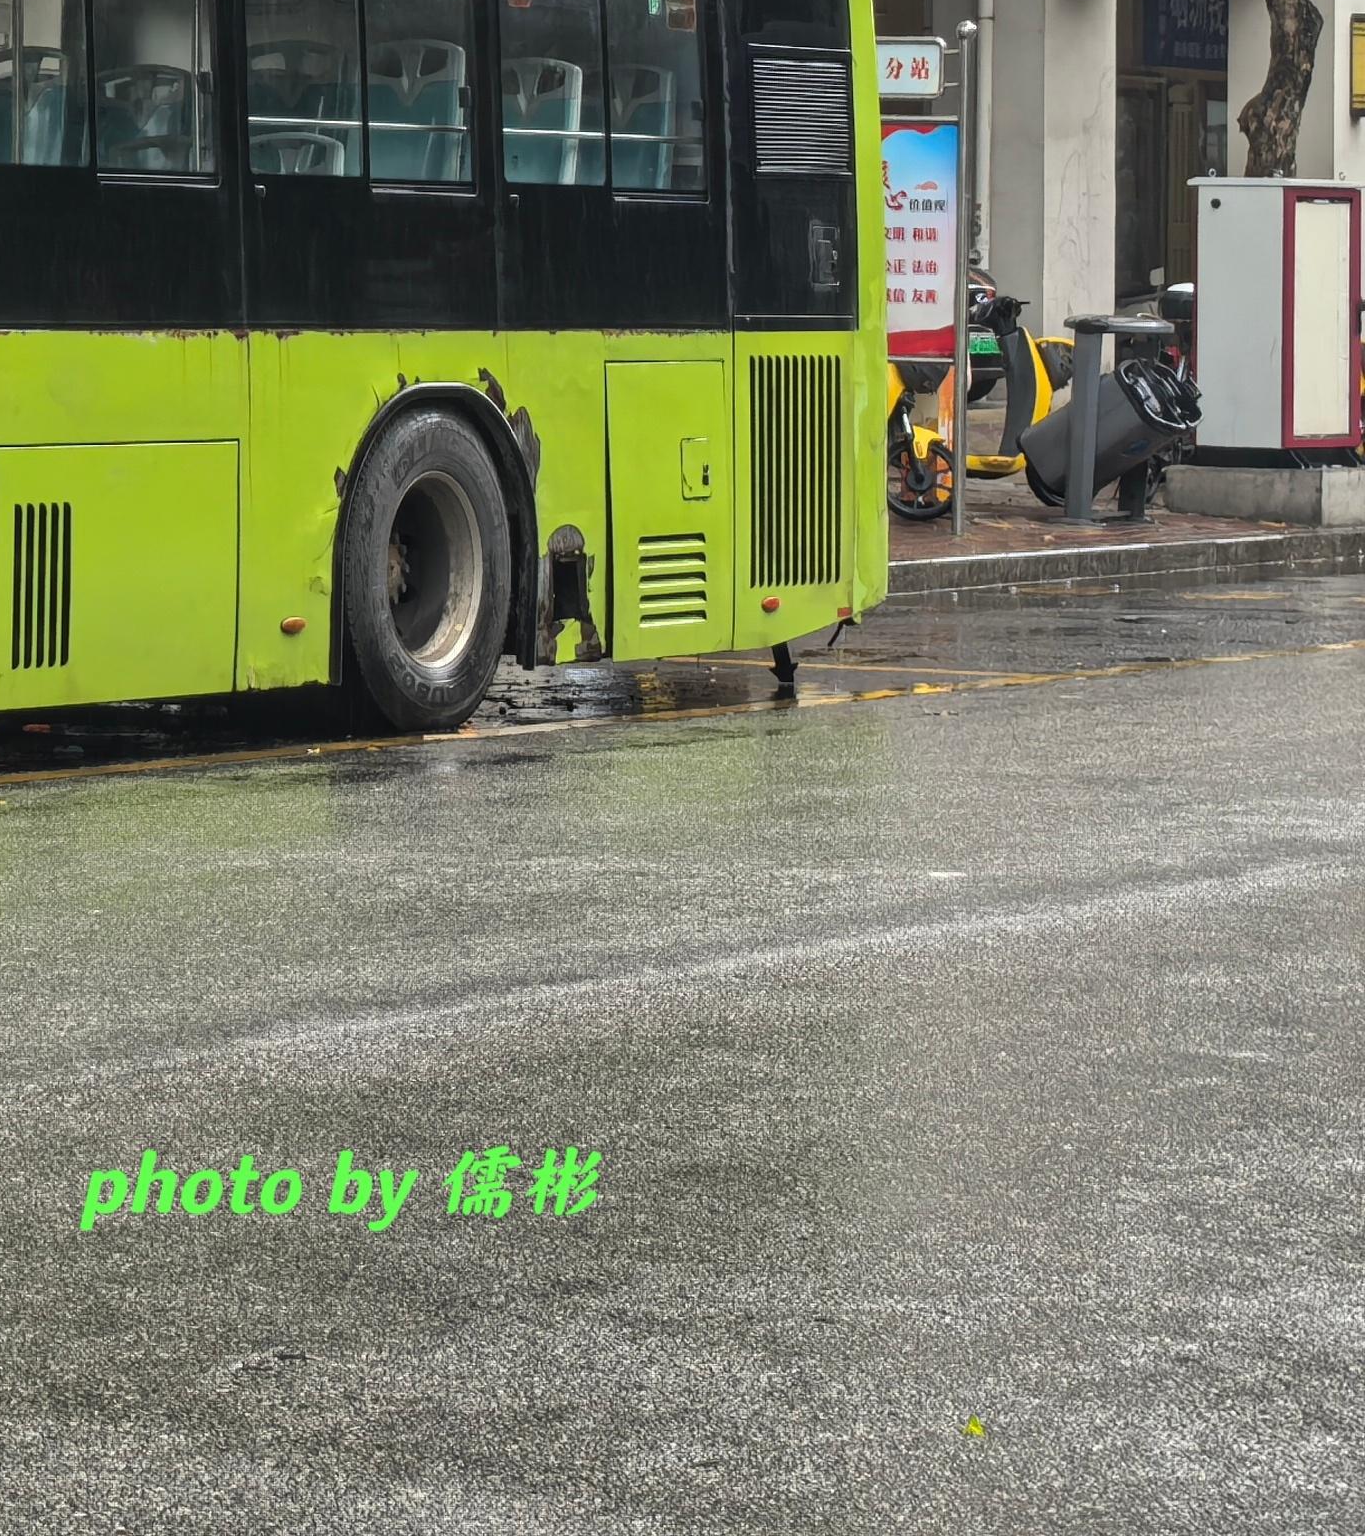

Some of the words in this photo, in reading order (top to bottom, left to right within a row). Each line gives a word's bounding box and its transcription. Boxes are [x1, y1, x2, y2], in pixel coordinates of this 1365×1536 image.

[885, 56, 930, 81] 分站
[909, 198, 947, 213] 价值观
[912, 227, 939, 242] 和谐
[912, 259, 939, 275] 法治
[912, 288, 937, 304] 友善
